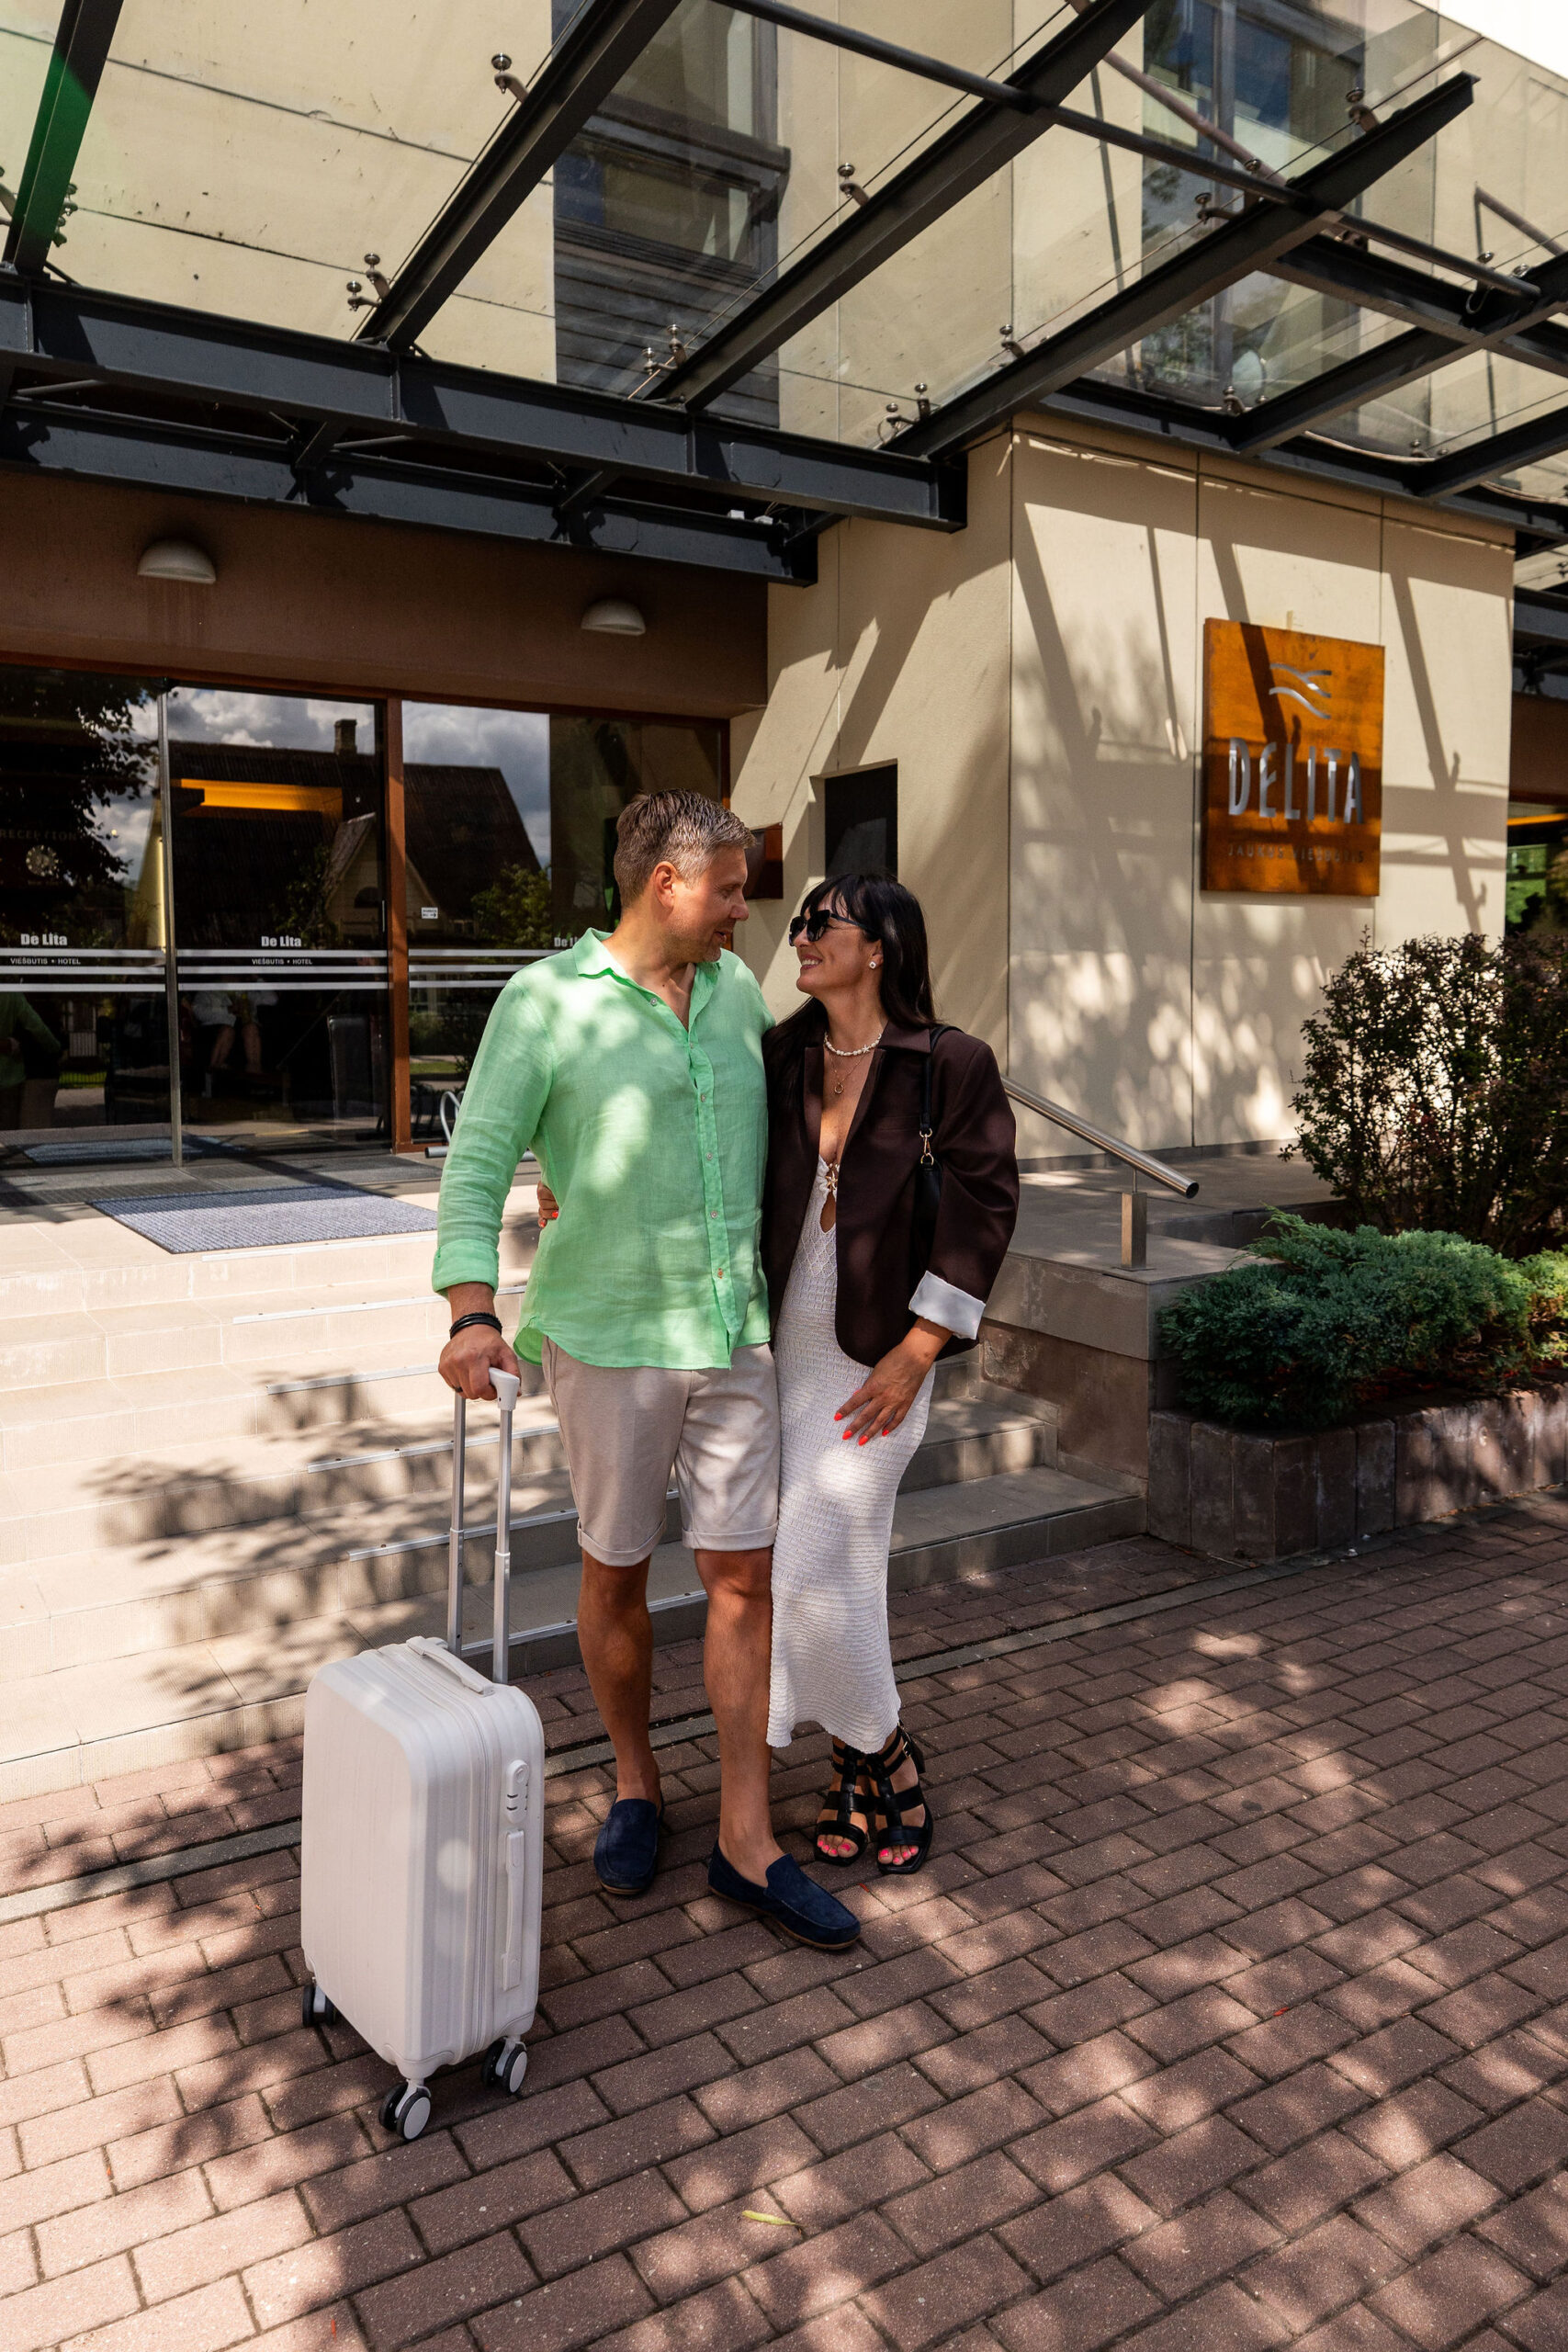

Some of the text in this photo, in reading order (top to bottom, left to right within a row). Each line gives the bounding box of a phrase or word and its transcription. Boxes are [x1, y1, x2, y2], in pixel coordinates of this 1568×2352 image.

[1229, 736, 1364, 824] DELITA
[20, 933, 68, 945] De Lita
[261, 934, 302, 947] De Lita
[10, 956, 48, 965] VIEŠBUTIS
[252, 957, 285, 966] VIEŠBUTIS
